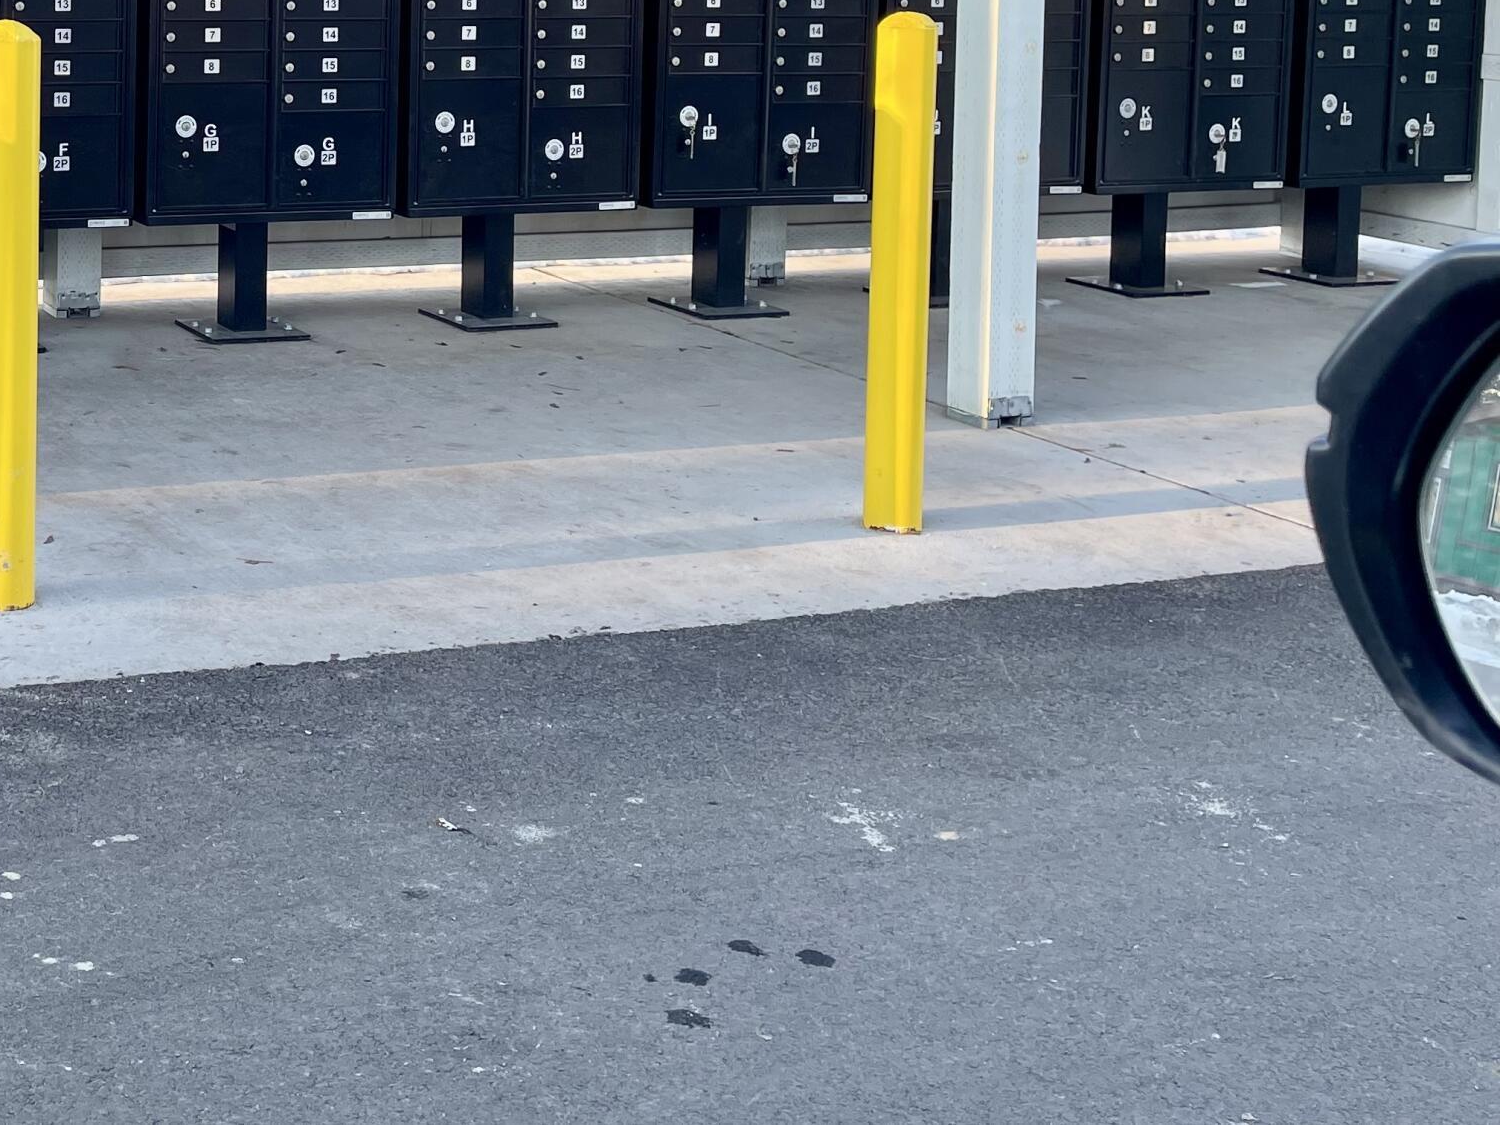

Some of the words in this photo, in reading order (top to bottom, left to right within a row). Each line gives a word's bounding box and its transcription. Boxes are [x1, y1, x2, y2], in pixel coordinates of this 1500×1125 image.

[57, 0, 69, 9] 13
[57, 31, 69, 41] 14
[56, 63, 68, 73] 15
[56, 94, 68, 105] 16
[204, 123, 217, 137] G
[463, 119, 474, 132] H
[59, 142, 69, 156] F
[322, 137, 335, 151] G
[55, 158, 67, 169] 2P
